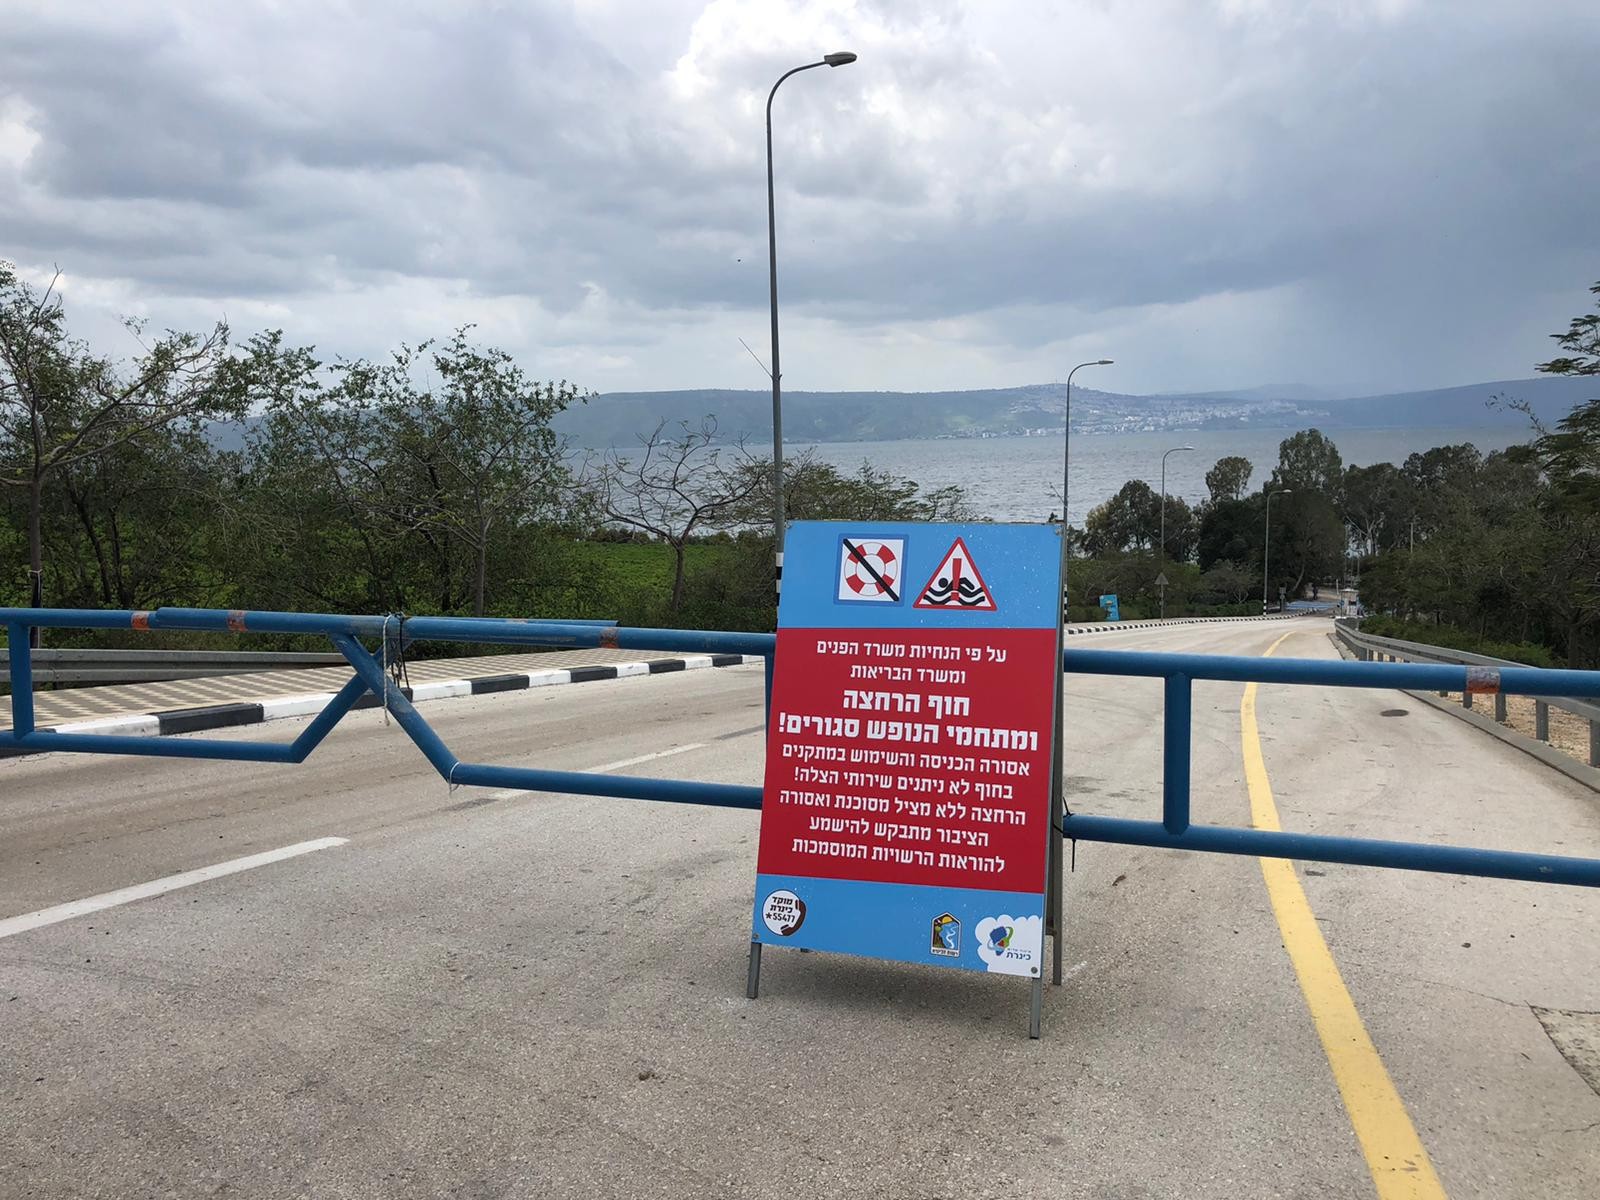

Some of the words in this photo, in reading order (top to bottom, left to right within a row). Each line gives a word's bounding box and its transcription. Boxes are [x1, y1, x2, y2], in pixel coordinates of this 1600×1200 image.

[817, 640, 858, 655] הפנים
[864, 643, 905, 657] משרד
[909, 645, 960, 660] הנחיות
[966, 648, 981, 661] פי
[987, 646, 1006, 662] על
[850, 665, 912, 681] הבריאות
[917, 668, 965, 684] ומשרד
[843, 690, 920, 713] הרחצה
[928, 695, 970, 720] חוף
[778, 712, 860, 738] סגורים!
[867, 720, 939, 744] הנופש
[947, 726, 1038, 751] ומתחמי
[783, 744, 845, 762] במתקנים
[851, 749, 914, 767] והשימוש
[920, 754, 974, 772] הכניסה
[980, 759, 1029, 776] אסורה
[794, 766, 838, 784] הצלה!
[844, 772, 892, 789] שירותי
[897, 777, 944, 793] ניתנים
[949, 779, 970, 795] לא
[975, 783, 1013, 800] בחוף
[780, 790, 830, 807] ואסורה
[834, 795, 889, 813] מסוכנת
[895, 797, 930, 817] מציל
[936, 801, 966, 819] ללא
[971, 807, 1026, 825] הרחצה
[809, 817, 869, 834] להישמע
[874, 823, 931, 841] מתבקש
[937, 829, 989, 847] הציבור
[792, 838, 867, 859] המוסמכות
[872, 847, 933, 867] הרשויות
[938, 854, 1005, 873] להוראות
[770, 904, 793, 914] כינרת
[772, 896, 793, 905] מוקד
[1006, 951, 1031, 961] כינרת
